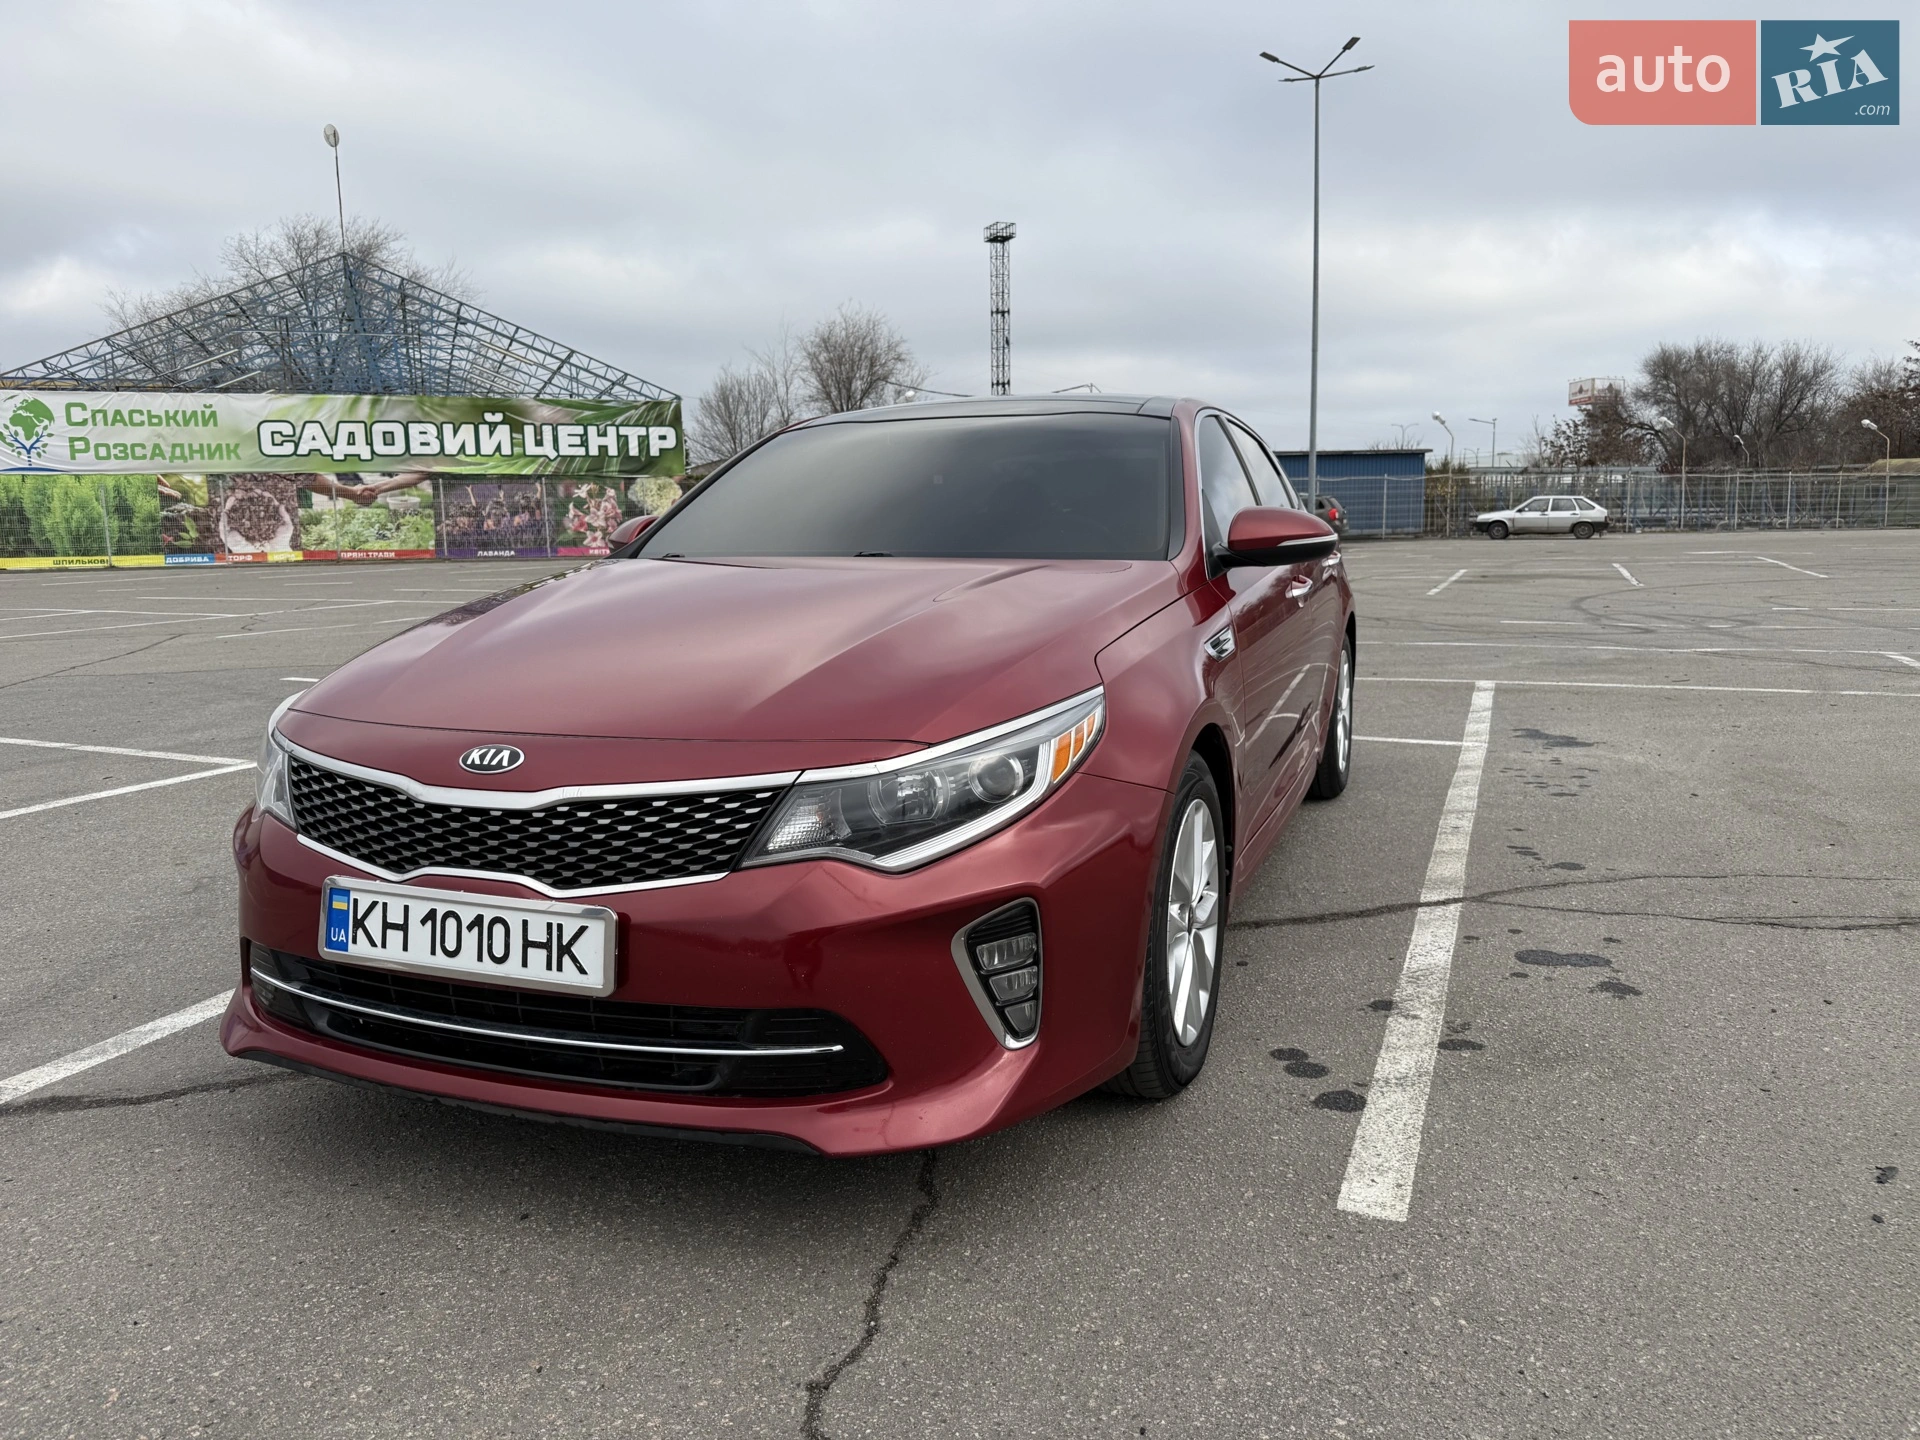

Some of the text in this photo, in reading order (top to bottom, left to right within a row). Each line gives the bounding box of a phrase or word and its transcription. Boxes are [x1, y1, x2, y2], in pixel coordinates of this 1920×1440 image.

[256, 411, 678, 462] САДОВИЙ ЦЕНТР
[165, 555, 210, 564] ДОБРИВА
[466, 749, 511, 766] KIA
[331, 928, 347, 943] UA
[419, 907, 511, 965] 1010
